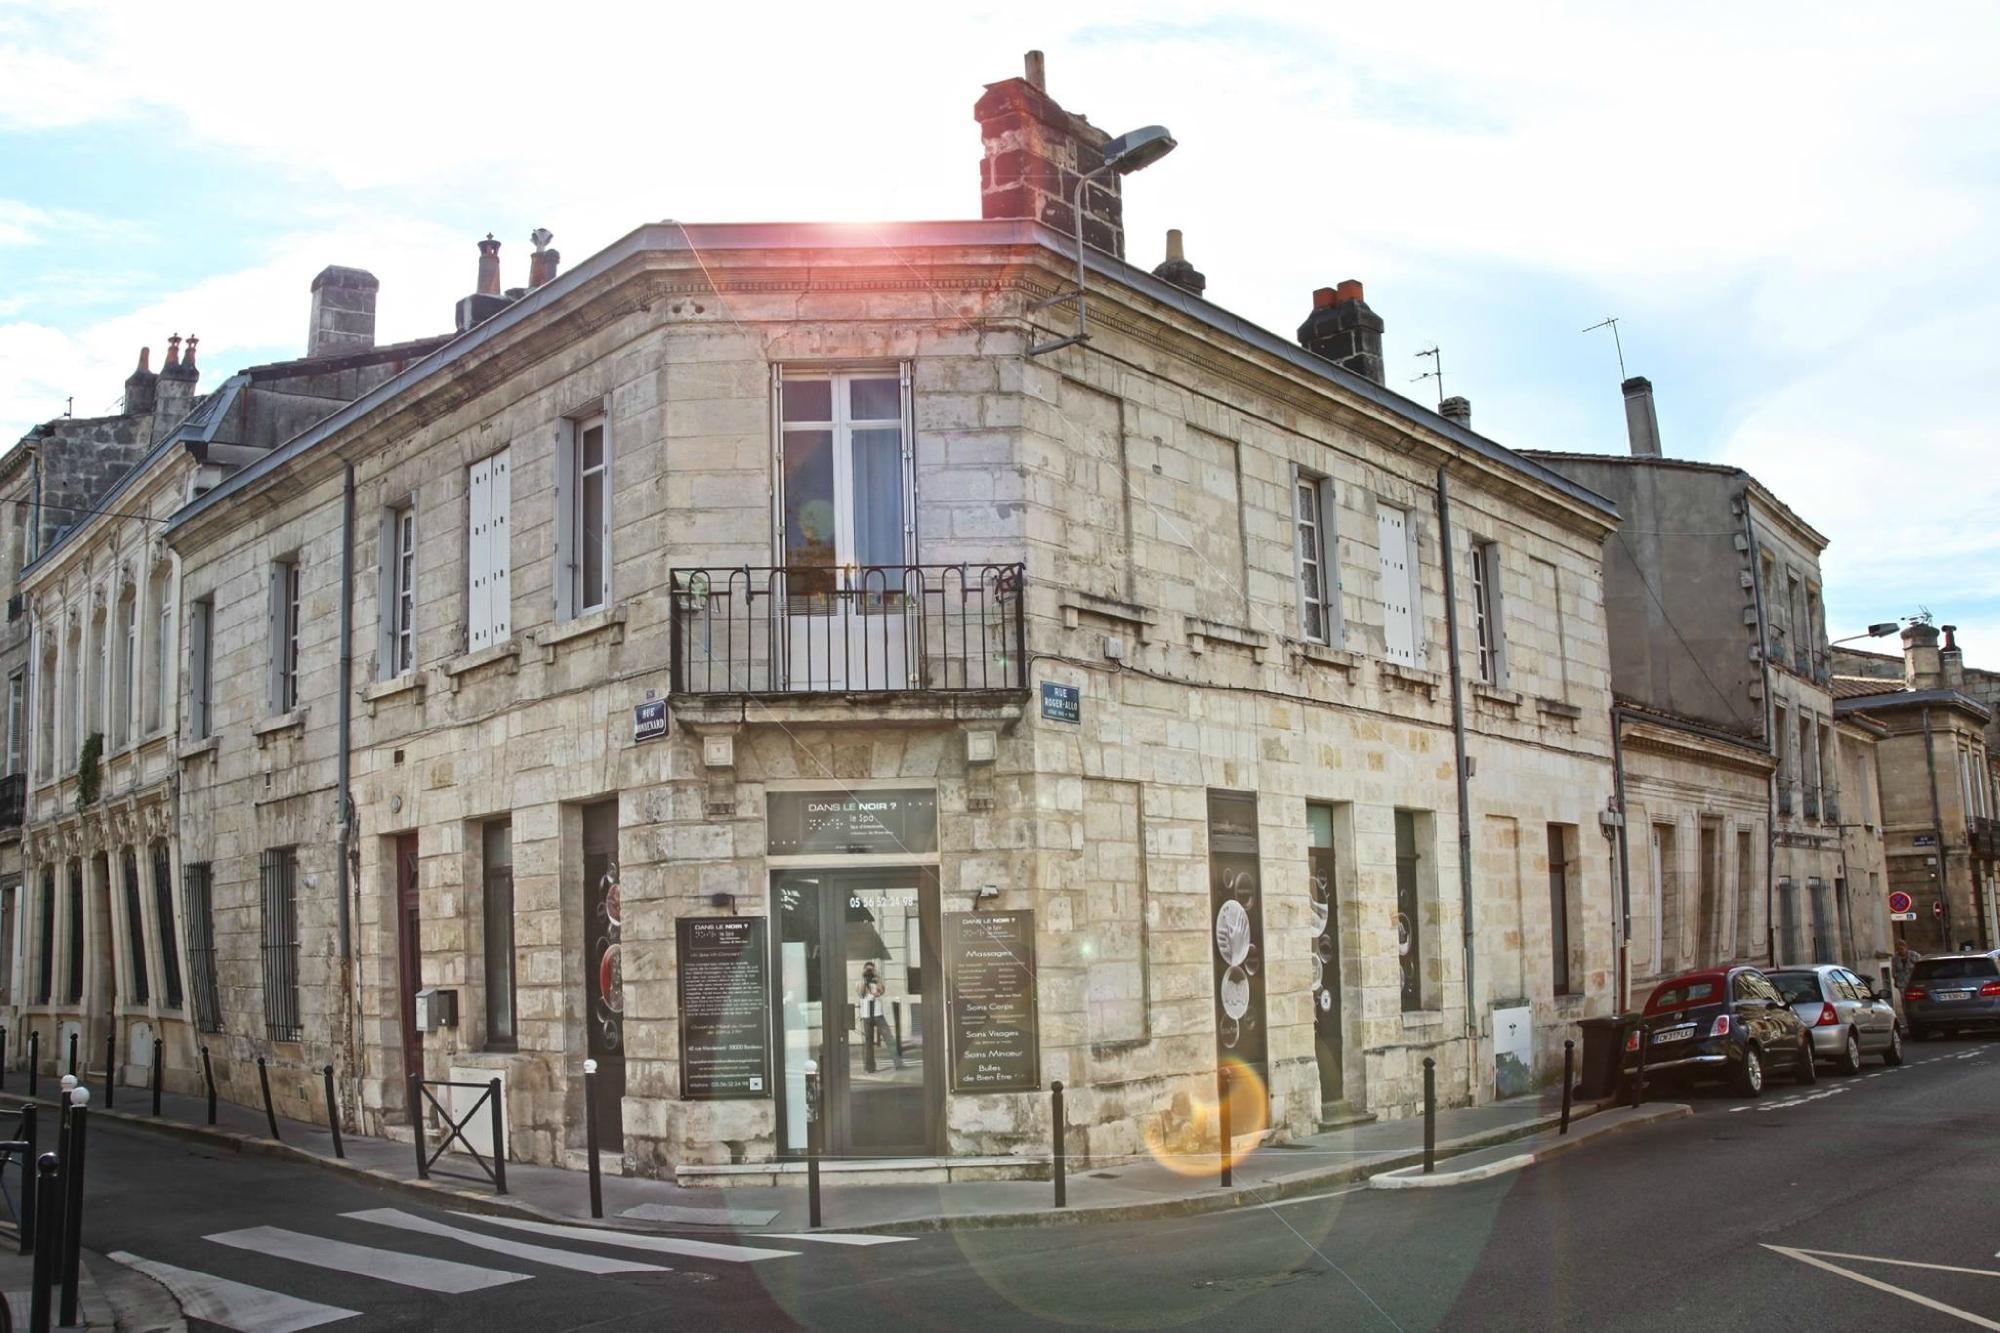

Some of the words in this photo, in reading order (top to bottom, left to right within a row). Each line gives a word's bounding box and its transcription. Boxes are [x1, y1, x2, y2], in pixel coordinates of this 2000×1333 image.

[1054, 687, 1067, 698] RUE
[808, 803, 840, 812] DANS
[843, 803, 856, 811] LE
[859, 802, 887, 810] NOIR
[890, 802, 897, 810] ?
[859, 814, 874, 822] Spa
[849, 897, 861, 908] 05
[902, 896, 914, 906] 98
[967, 1003, 987, 1011] Soins
[989, 1002, 1014, 1011] Corps
[988, 1030, 1019, 1038] Visages
[964, 1050, 987, 1058] Soins
[979, 1064, 1001, 1072] Bulles
[963, 1074, 974, 1082] de
